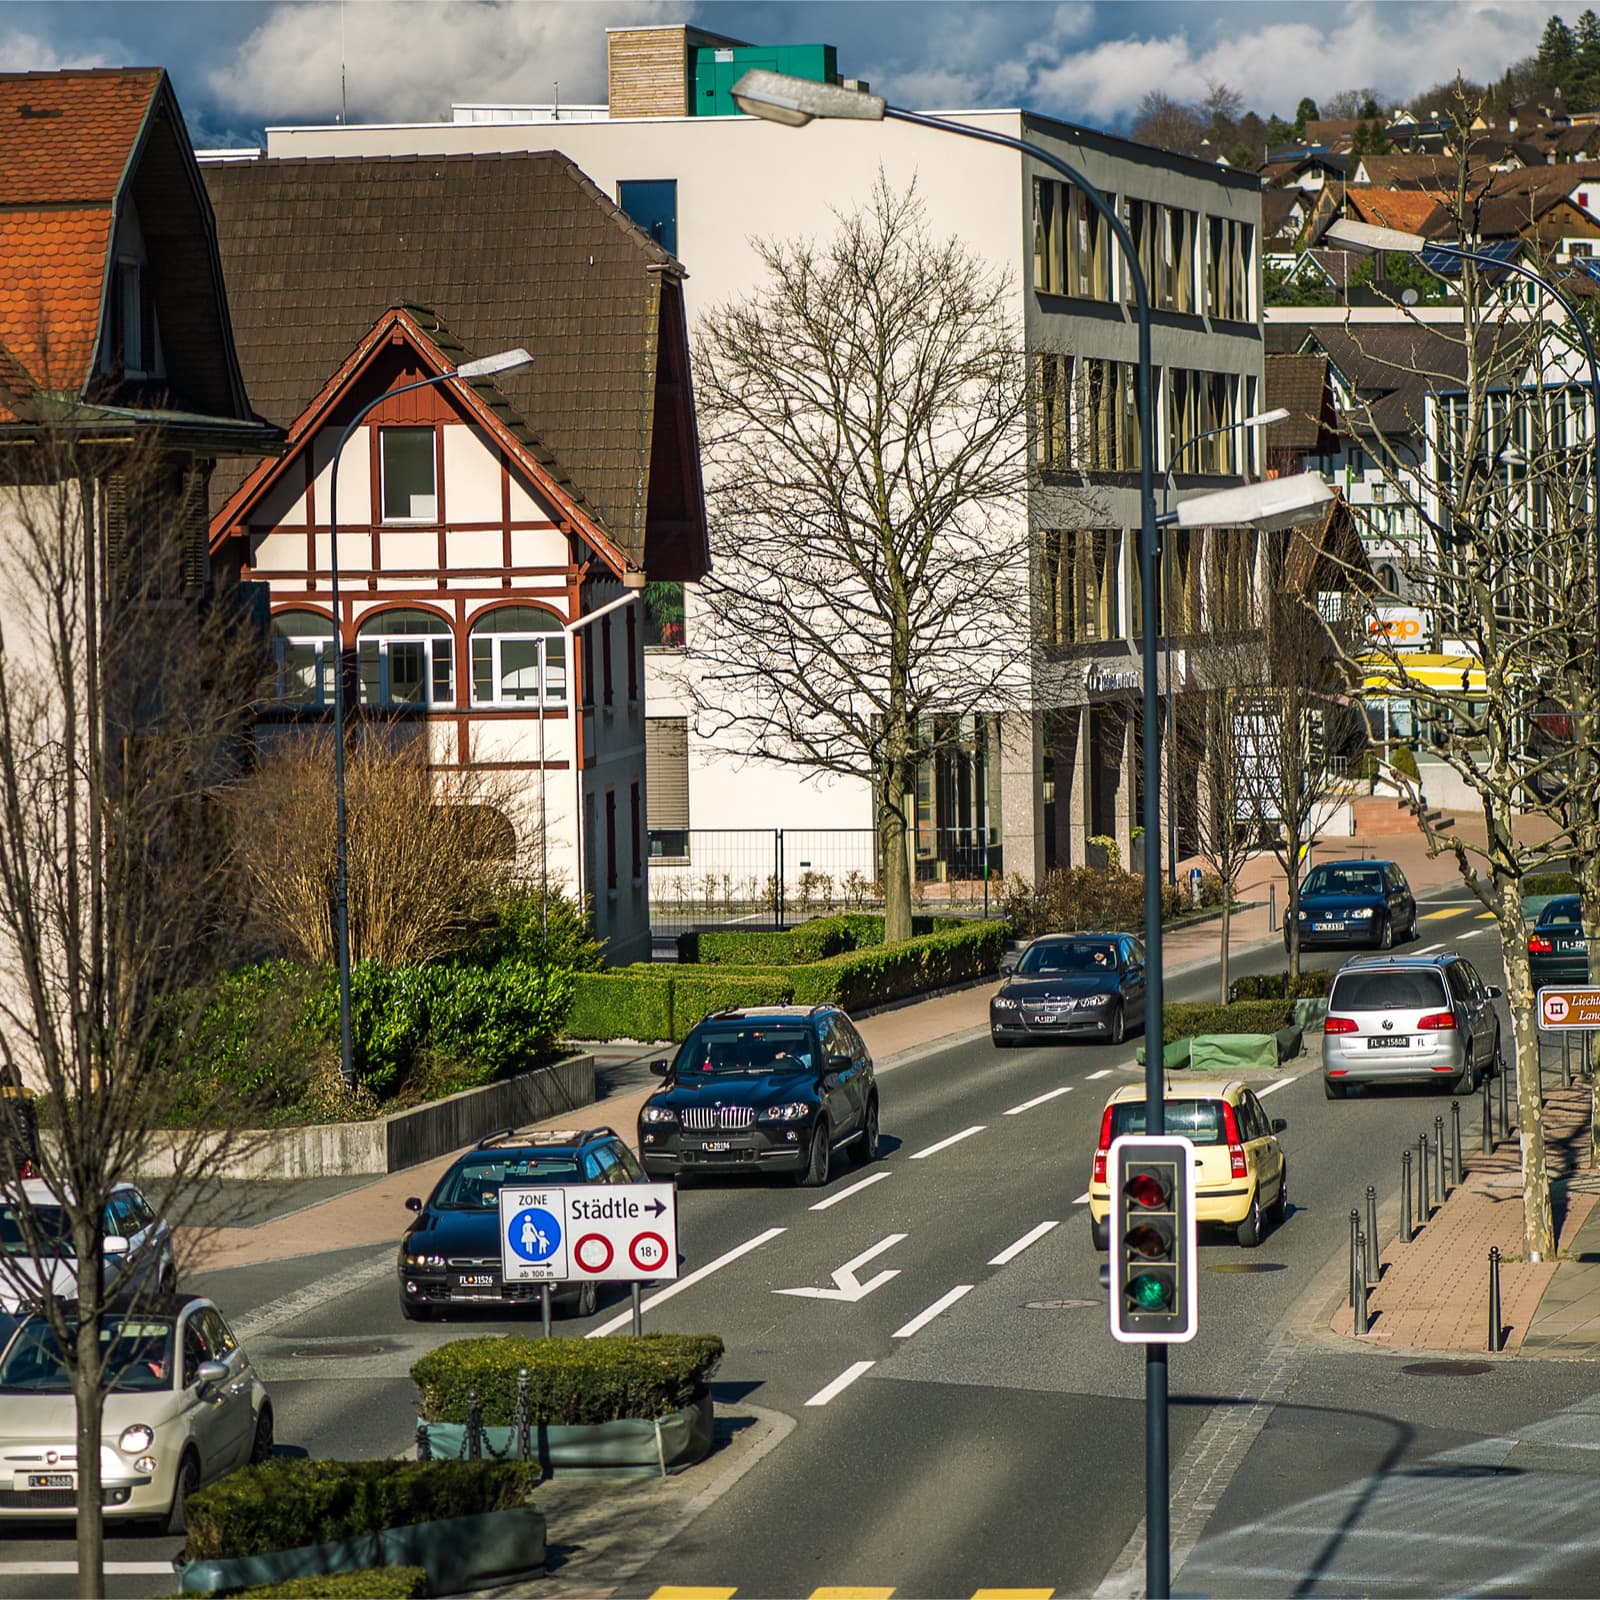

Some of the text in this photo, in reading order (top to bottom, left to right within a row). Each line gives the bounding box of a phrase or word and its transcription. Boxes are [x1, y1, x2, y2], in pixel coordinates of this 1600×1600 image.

[1571, 994, 1600, 1006] Liecht
[518, 1194, 548, 1206] ZONE
[571, 1197, 639, 1220] Städtle
[640, 1246, 652, 1257] 18
[459, 1275, 467, 1284] FL
[519, 1270, 529, 1278] ab
[532, 1270, 545, 1278] 100
